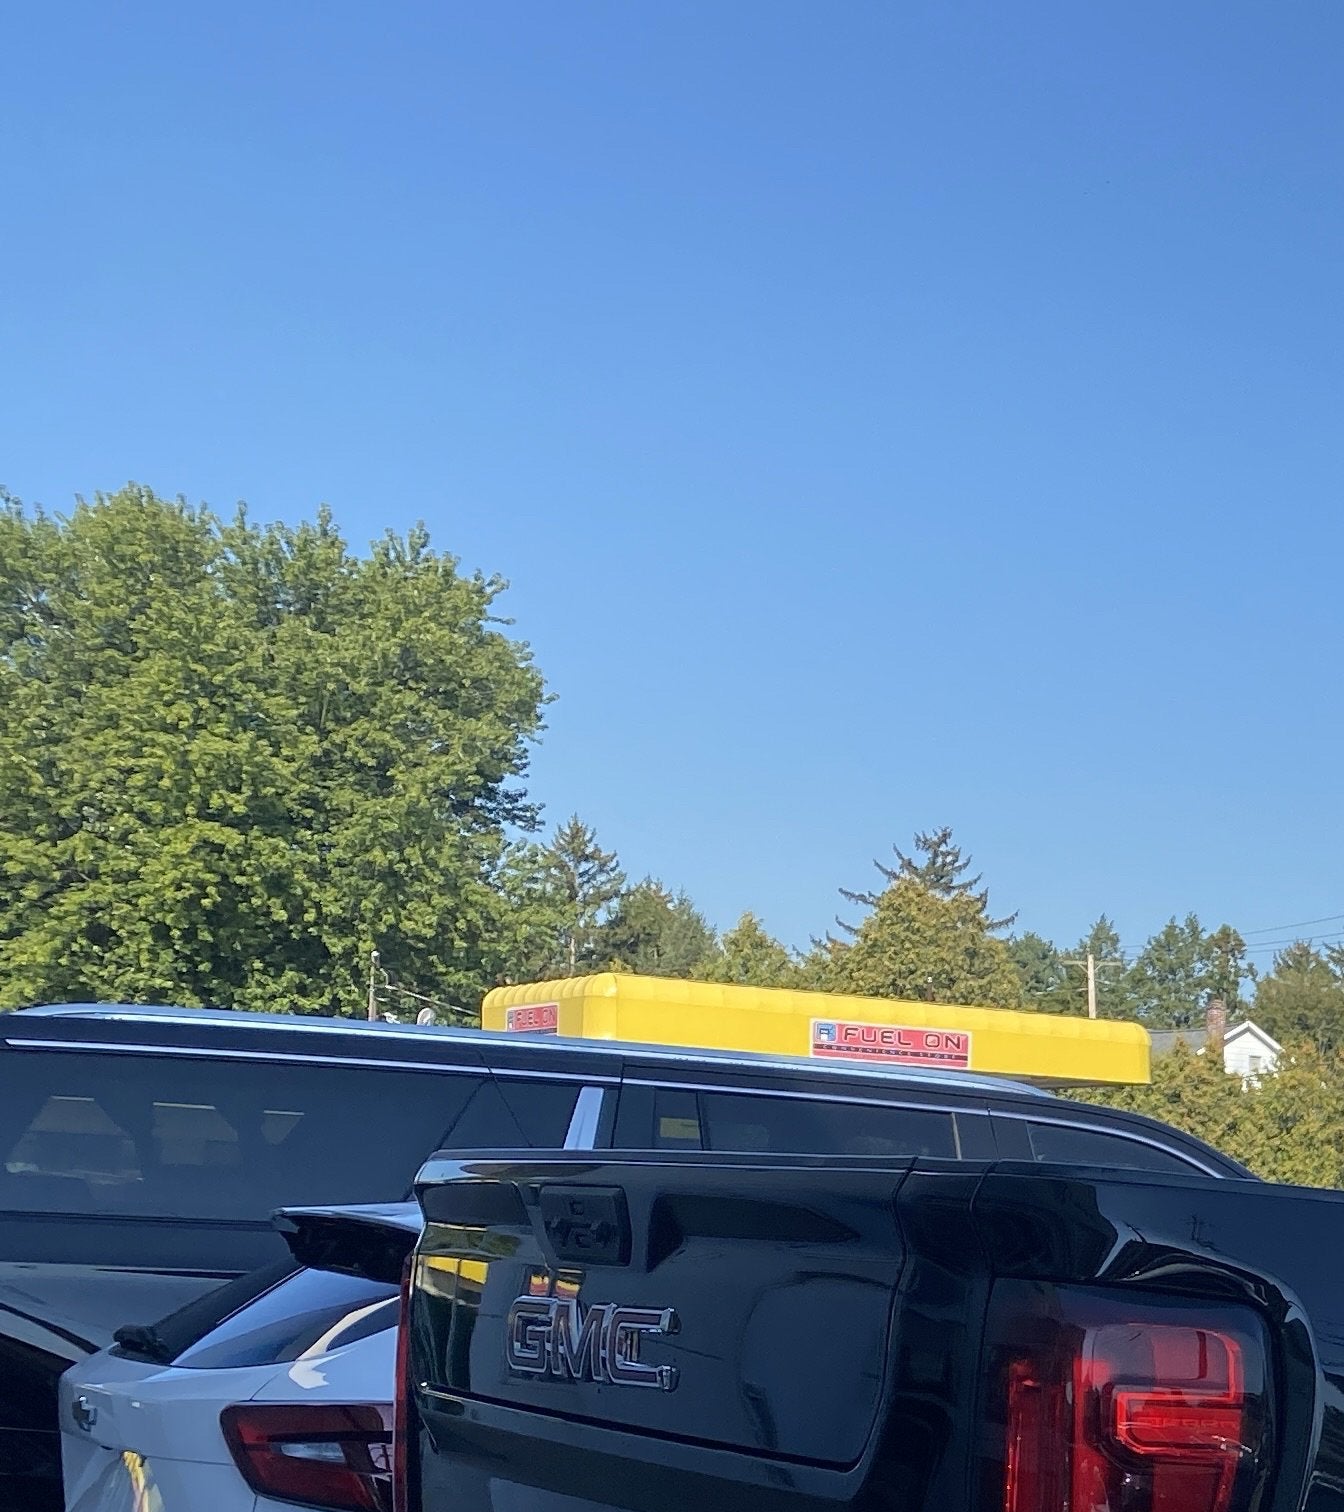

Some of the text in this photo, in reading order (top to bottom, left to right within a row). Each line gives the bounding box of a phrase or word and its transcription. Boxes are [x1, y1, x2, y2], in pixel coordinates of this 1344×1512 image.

[516, 1009, 539, 1027] FUEL
[843, 1027, 961, 1050] FUEL ON
[507, 1295, 682, 1392] GMC
